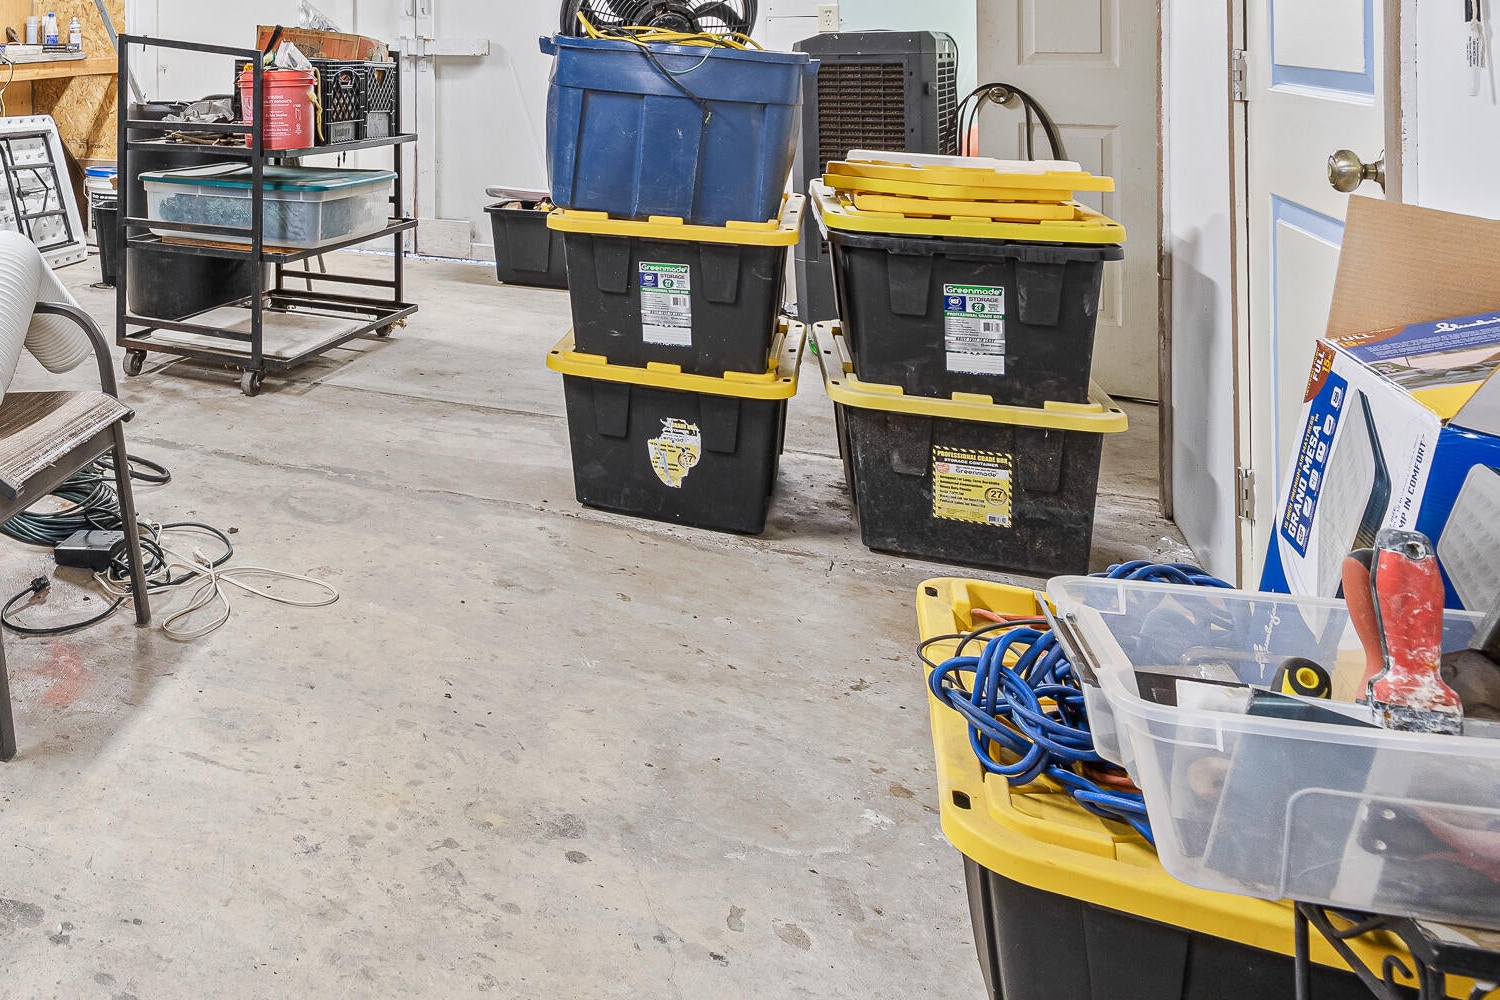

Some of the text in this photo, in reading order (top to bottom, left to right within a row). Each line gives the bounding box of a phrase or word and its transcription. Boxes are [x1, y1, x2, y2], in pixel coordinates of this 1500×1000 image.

[641, 263, 687, 273] Greenmade
[946, 286, 1002, 296] Greenmade
[1312, 350, 1325, 382] FULL
[1298, 453, 1306, 468] AIR
[1302, 415, 1315, 455] MATTRESS
[937, 450, 976, 460] PROFESSIONAL
[955, 468, 997, 478] Greenmade
[1408, 441, 1427, 497] COMFORT
[990, 490, 1003, 499] 27
[1288, 476, 1309, 536] GRAND
